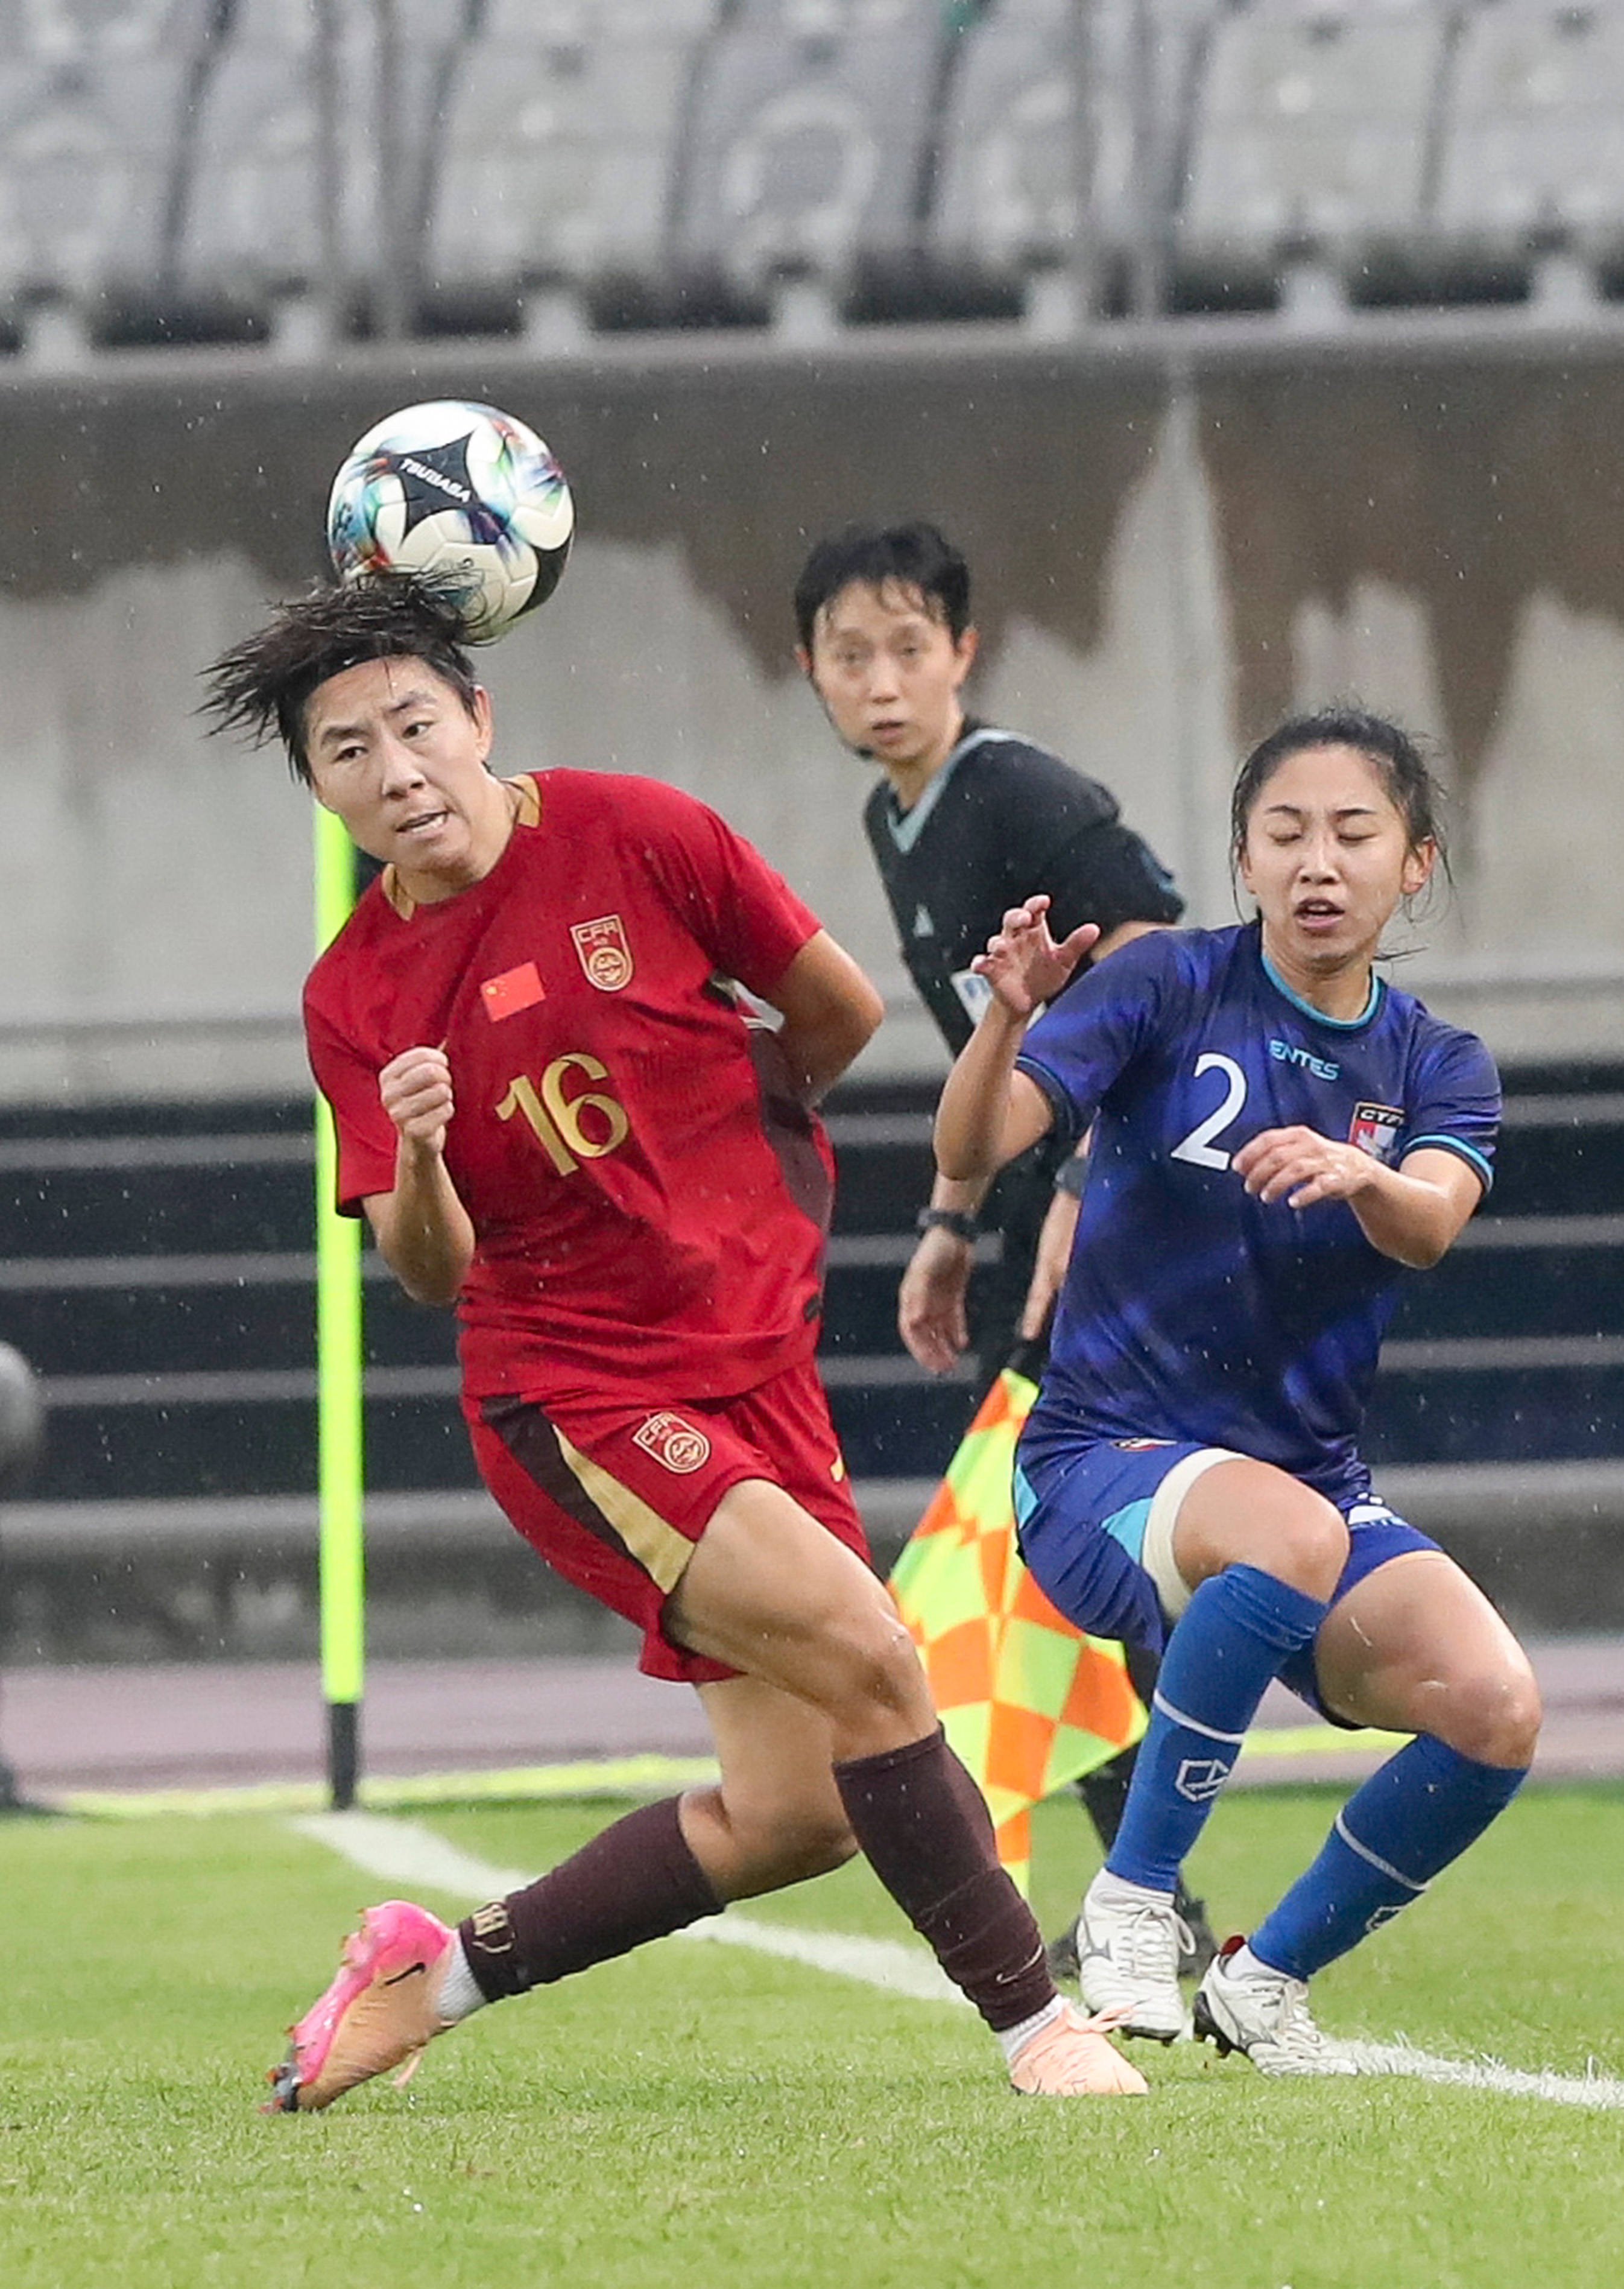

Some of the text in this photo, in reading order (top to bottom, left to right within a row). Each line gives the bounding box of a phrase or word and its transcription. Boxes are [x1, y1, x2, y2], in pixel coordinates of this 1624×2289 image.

[399, 458, 471, 503] TSUBASA
[1269, 1039, 1339, 1081] ENTES
[494, 1052, 630, 1177] 16
[1170, 1053, 1247, 1171] 2
